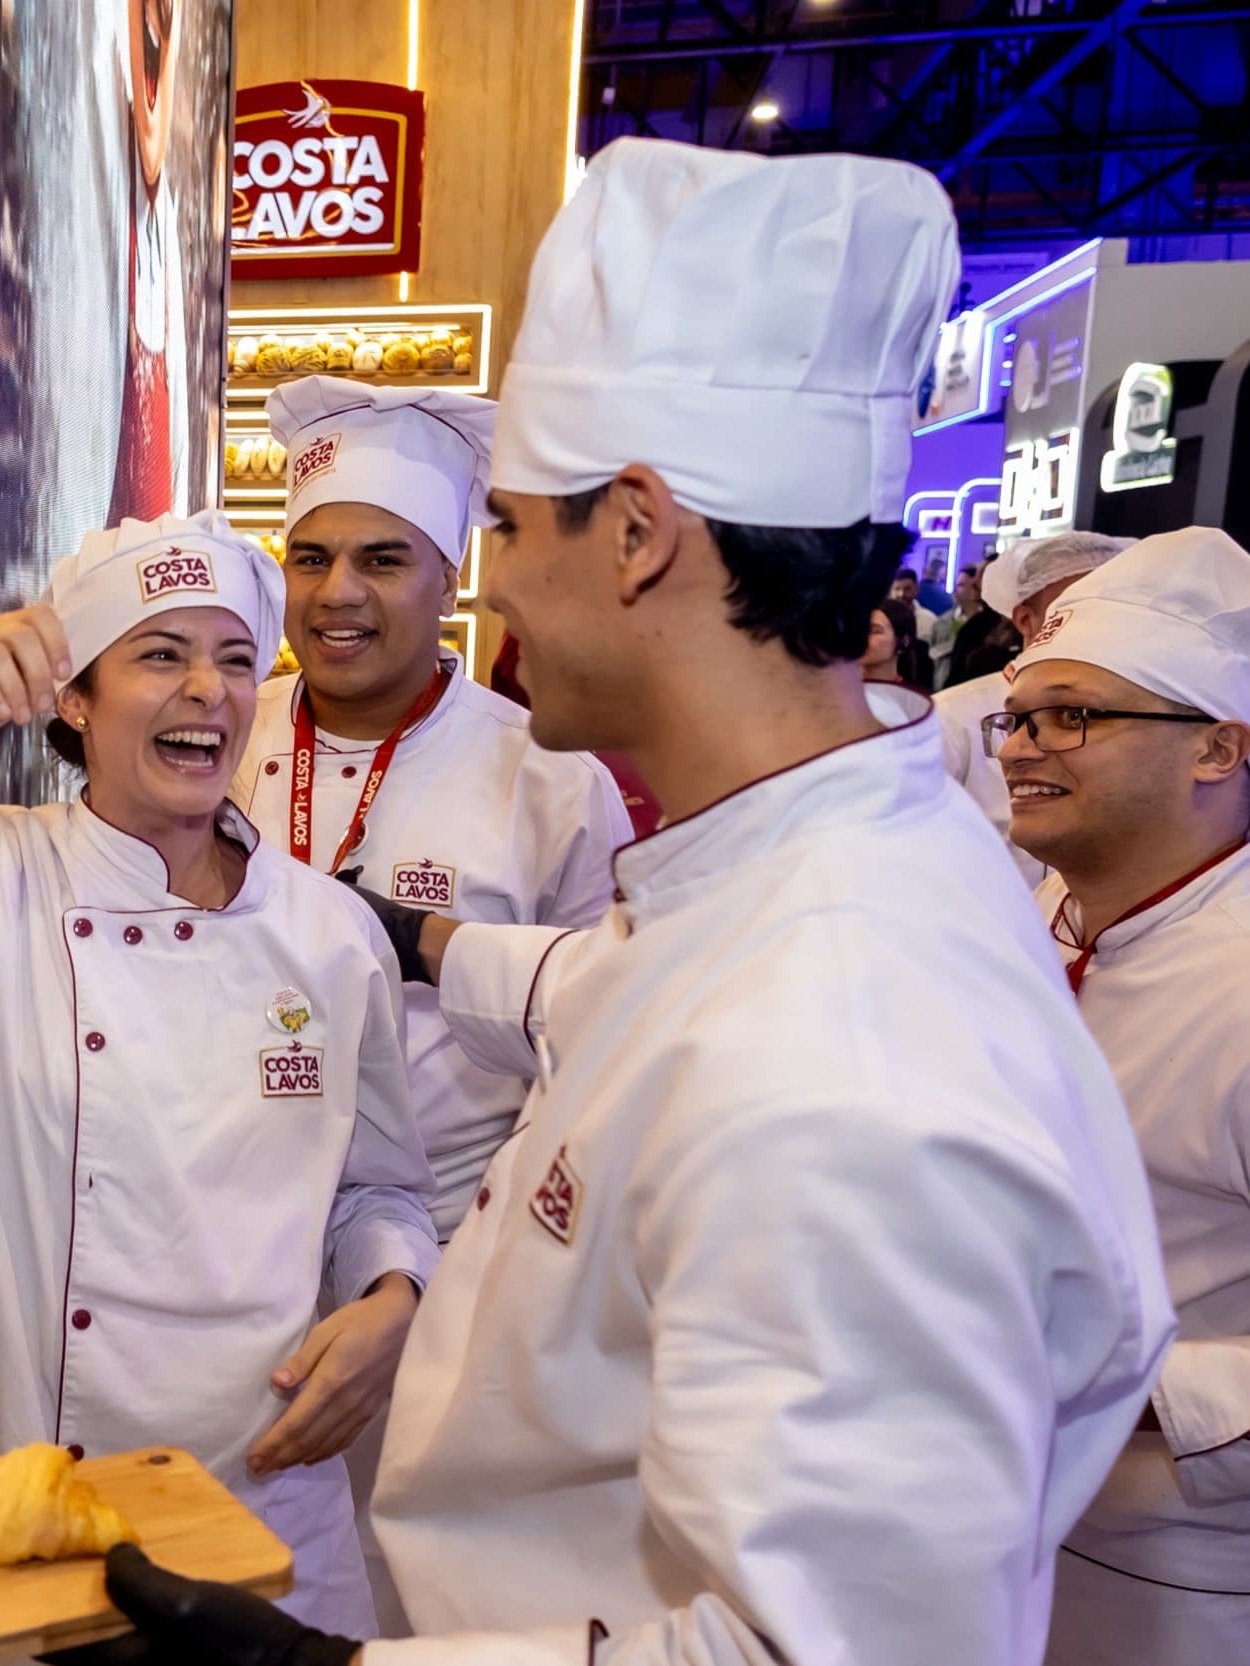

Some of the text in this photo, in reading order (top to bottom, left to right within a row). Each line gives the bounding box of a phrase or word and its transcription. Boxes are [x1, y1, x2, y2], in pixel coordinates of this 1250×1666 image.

[295, 441, 334, 472] COSTA
[143, 558, 207, 578] COSTA
[145, 572, 210, 595] LAVOS
[293, 748, 311, 846] COSTA LAVOS
[359, 770, 383, 813] LAVOS
[397, 870, 449, 887] COSTA
[395, 884, 449, 901] LAVOS
[264, 1056, 319, 1073] COSTA
[265, 1074, 320, 1091] LAVOS
